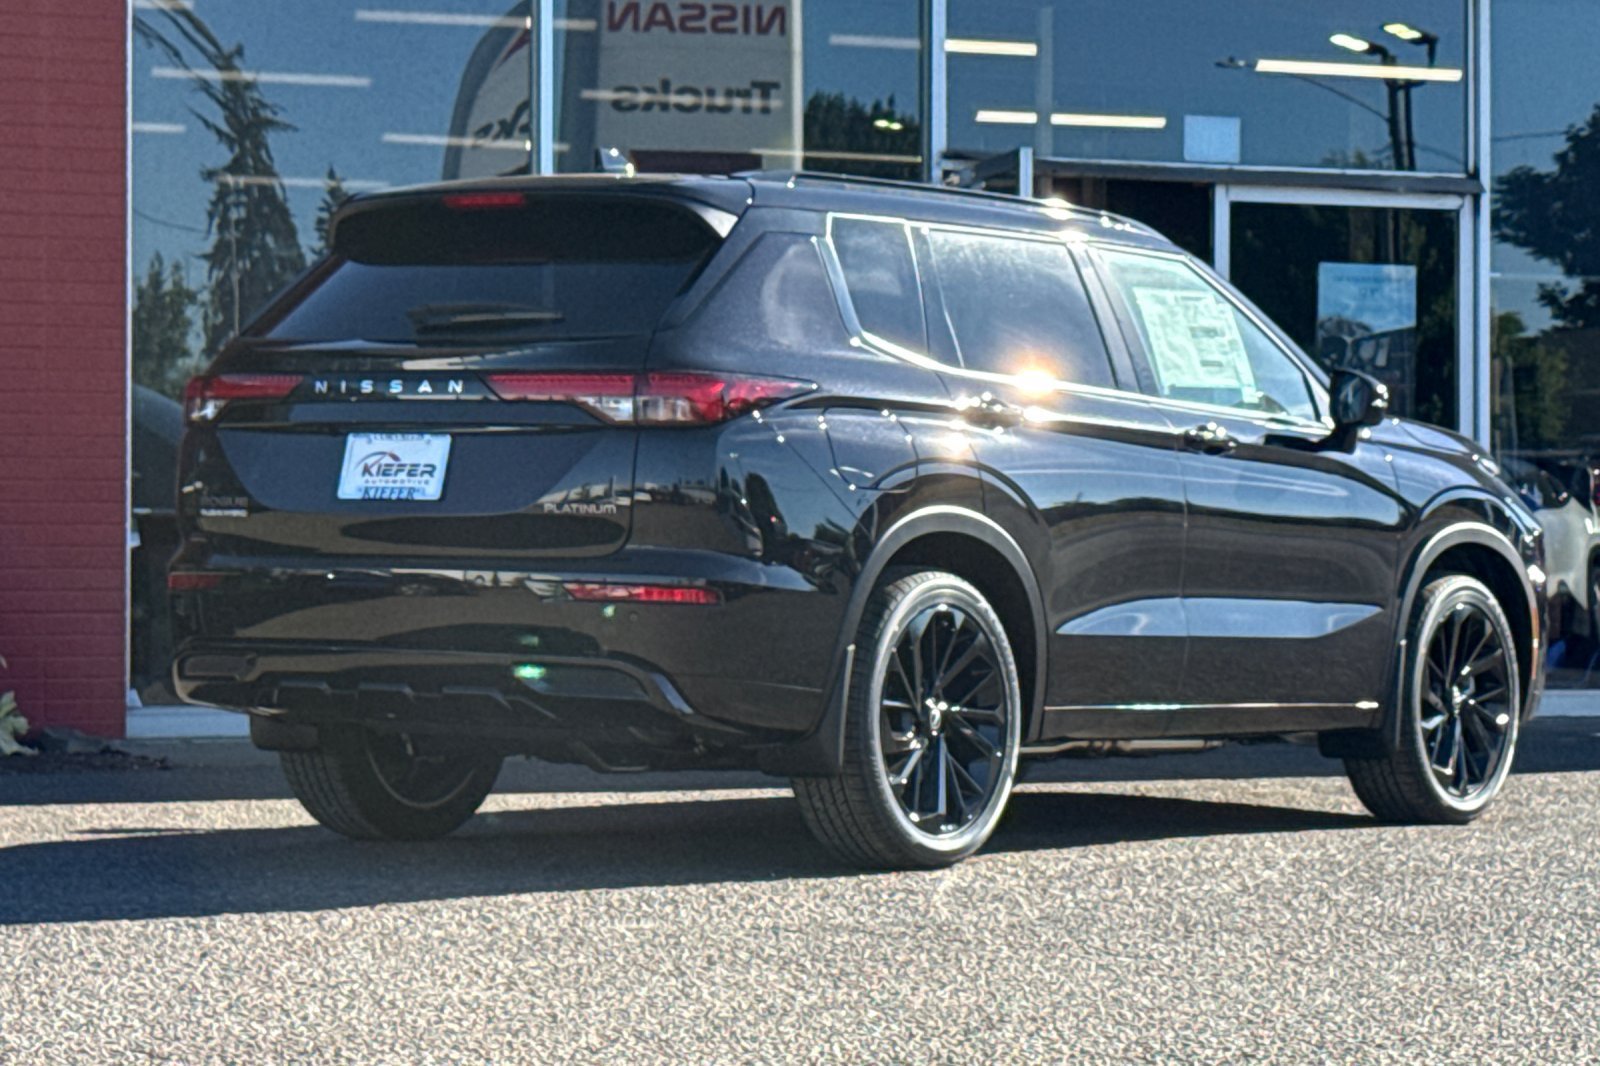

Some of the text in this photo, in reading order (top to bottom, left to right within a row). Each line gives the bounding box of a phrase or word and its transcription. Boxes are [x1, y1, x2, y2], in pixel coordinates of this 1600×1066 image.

[314, 379, 464, 394] NISSAN
[361, 461, 437, 478] KIEFER
[362, 486, 416, 499] KIEFER
[543, 503, 617, 514] PLATINUM
